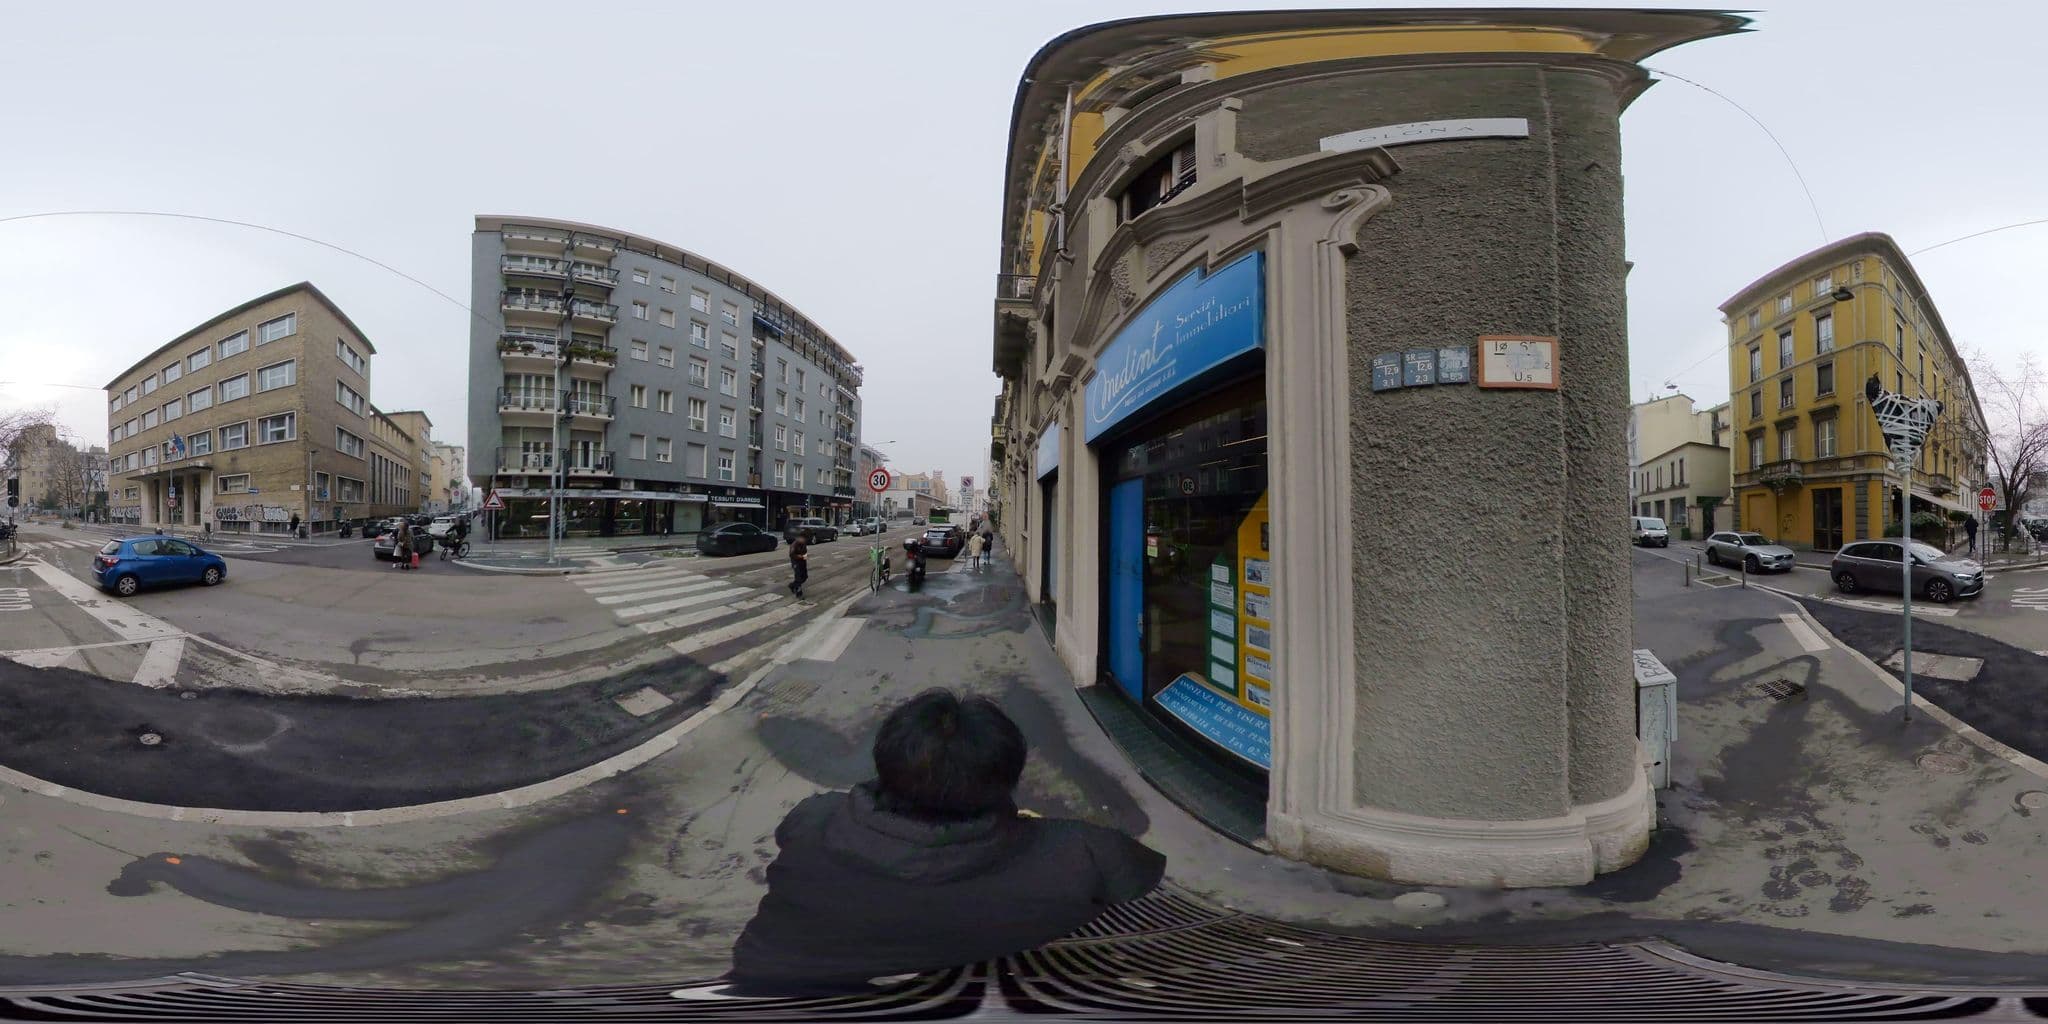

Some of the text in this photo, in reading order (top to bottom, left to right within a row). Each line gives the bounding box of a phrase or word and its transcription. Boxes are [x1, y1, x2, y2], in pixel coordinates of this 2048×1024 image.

[1358, 126, 1474, 144] OLONA
[1175, 295, 1216, 329] Servizi
[1176, 296, 1250, 345] Immobiliari
[873, 474, 886, 486] 30
[710, 495, 735, 503] TESSUTI
[1979, 495, 1996, 505] STOP
[1216, 699, 1234, 714] PER
